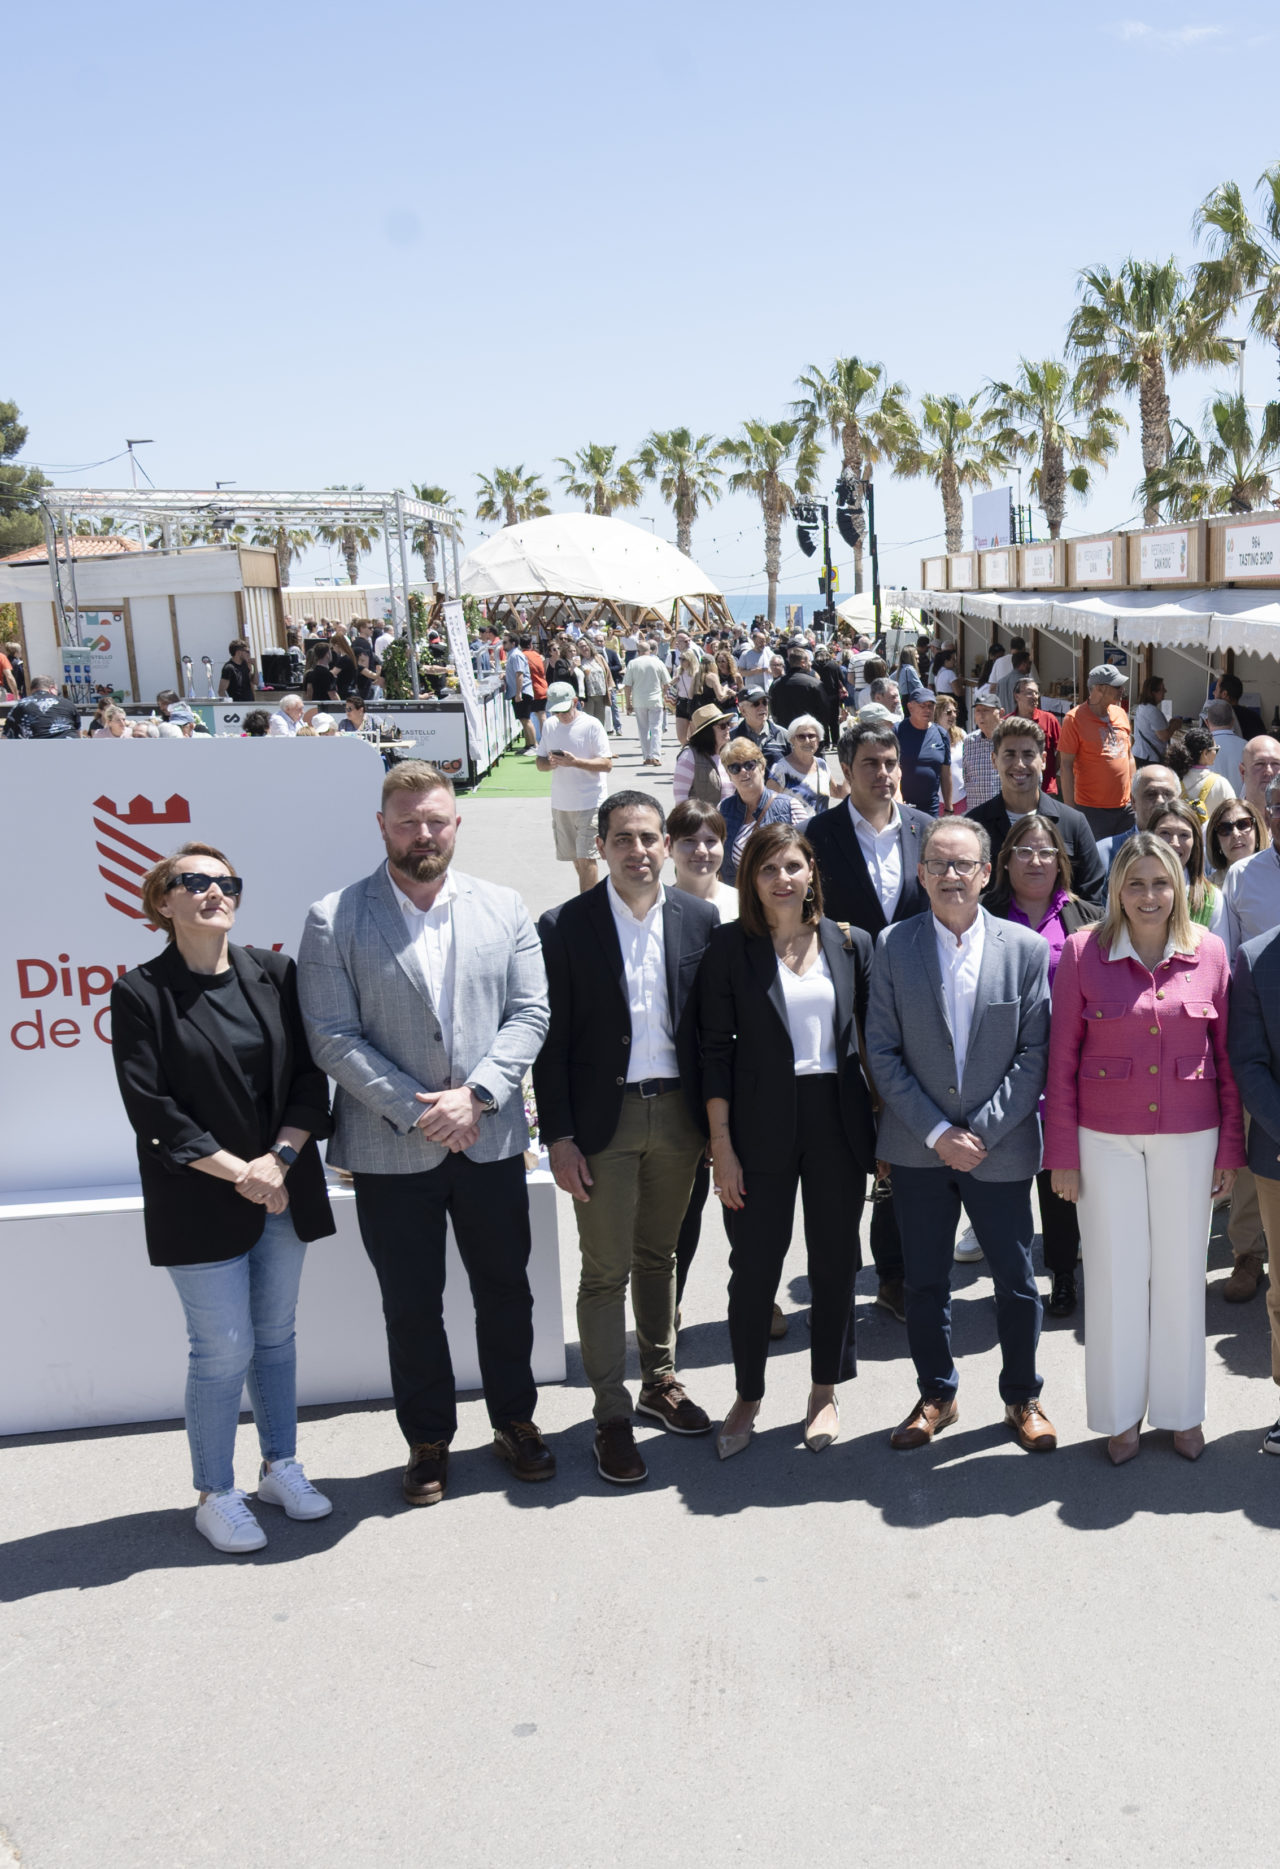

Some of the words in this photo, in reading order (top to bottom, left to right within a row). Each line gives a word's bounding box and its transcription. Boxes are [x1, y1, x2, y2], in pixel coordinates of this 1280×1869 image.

[1239, 553, 1259, 566] TASTING
[1260, 551, 1273, 565] SHOP
[10, 1009, 81, 1051] de
